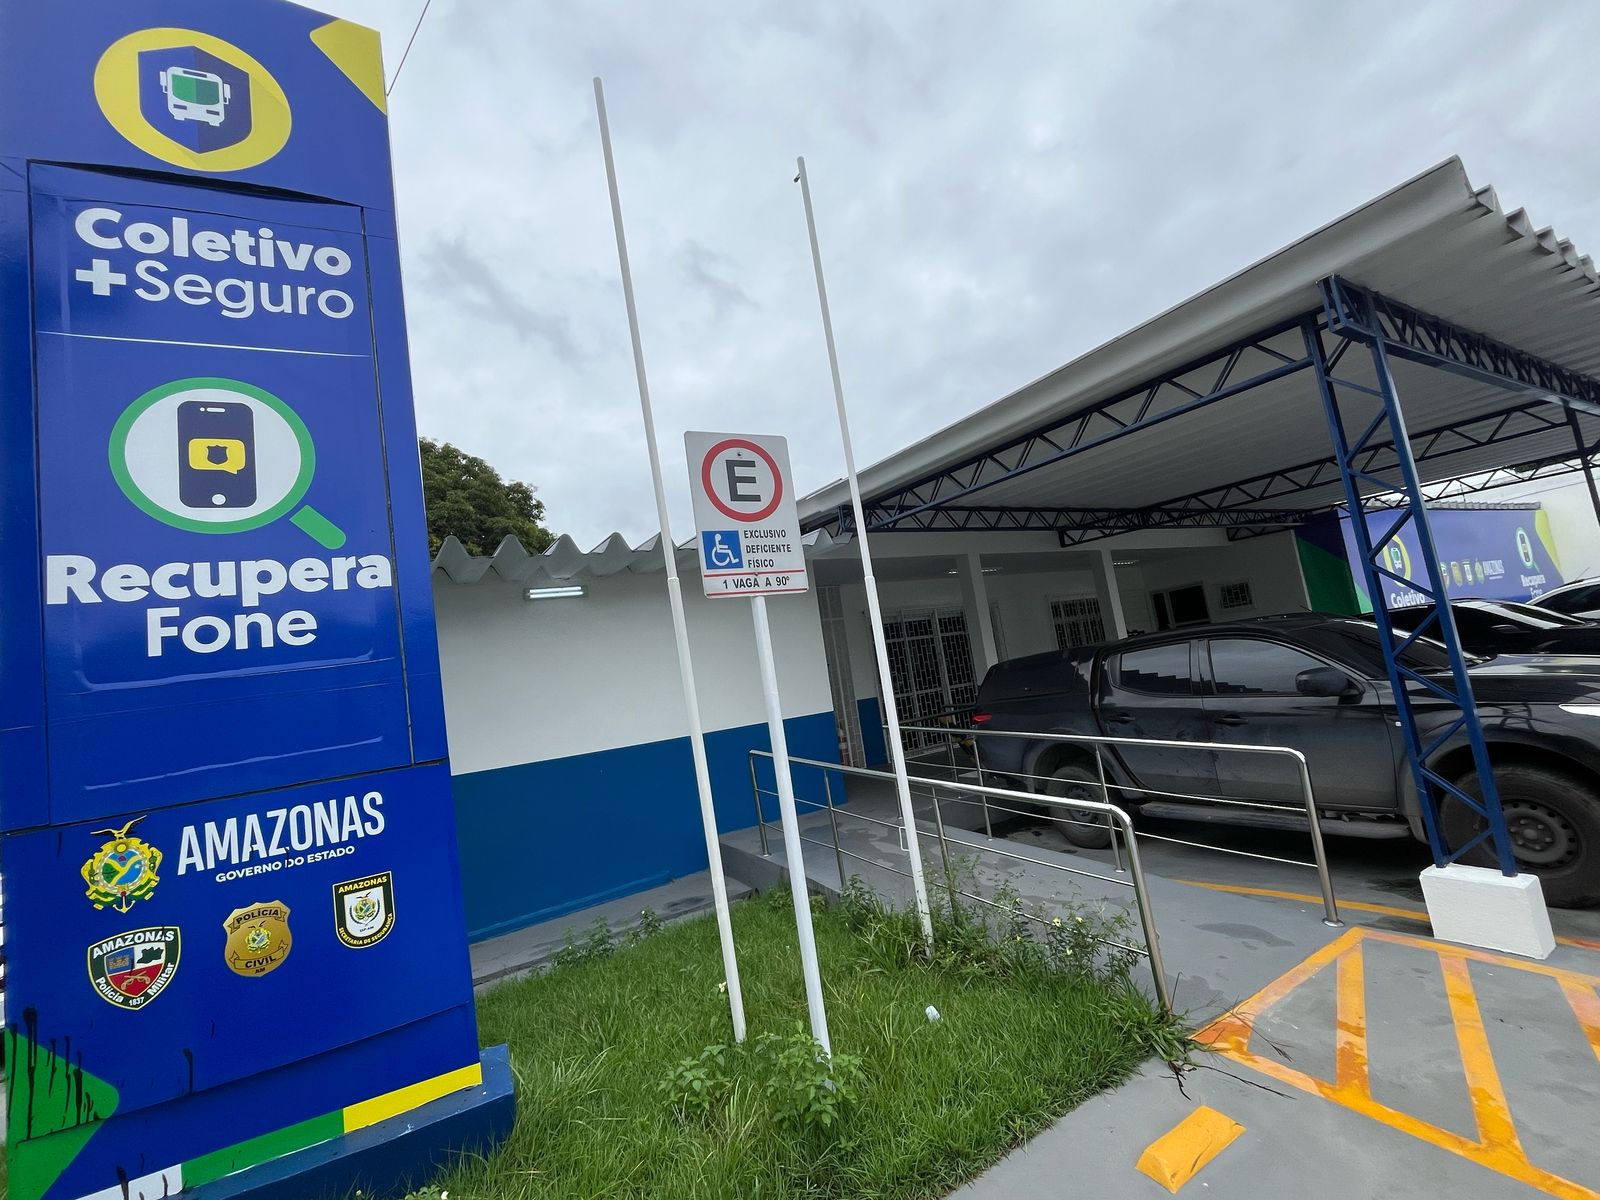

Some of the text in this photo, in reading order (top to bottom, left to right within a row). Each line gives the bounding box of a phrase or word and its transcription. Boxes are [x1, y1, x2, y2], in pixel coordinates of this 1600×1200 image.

[75, 207, 352, 276] Coletivo
[725, 459, 761, 502] E
[743, 530, 786, 539] EXCLUSIVO
[746, 544, 792, 553] DEFICIENTE
[748, 557, 774, 568] FÍSICO
[46, 553, 392, 607] Recupera
[723, 580, 728, 589] 1
[732, 577, 760, 589] VAGA
[765, 577, 772, 587] A
[1390, 590, 1426, 608] Coletivo
[147, 606, 317, 657] Fone
[177, 791, 385, 876] AMAZONAS
[215, 859, 282, 883] GOVERNO
[307, 845, 355, 864] ESTADO
[338, 876, 388, 894] AMAZONAS
[93, 930, 175, 959] AMAZONAS
[245, 955, 276, 968] CIVIL
[128, 997, 145, 1006] 1837
[146, 962, 175, 996] Militar
